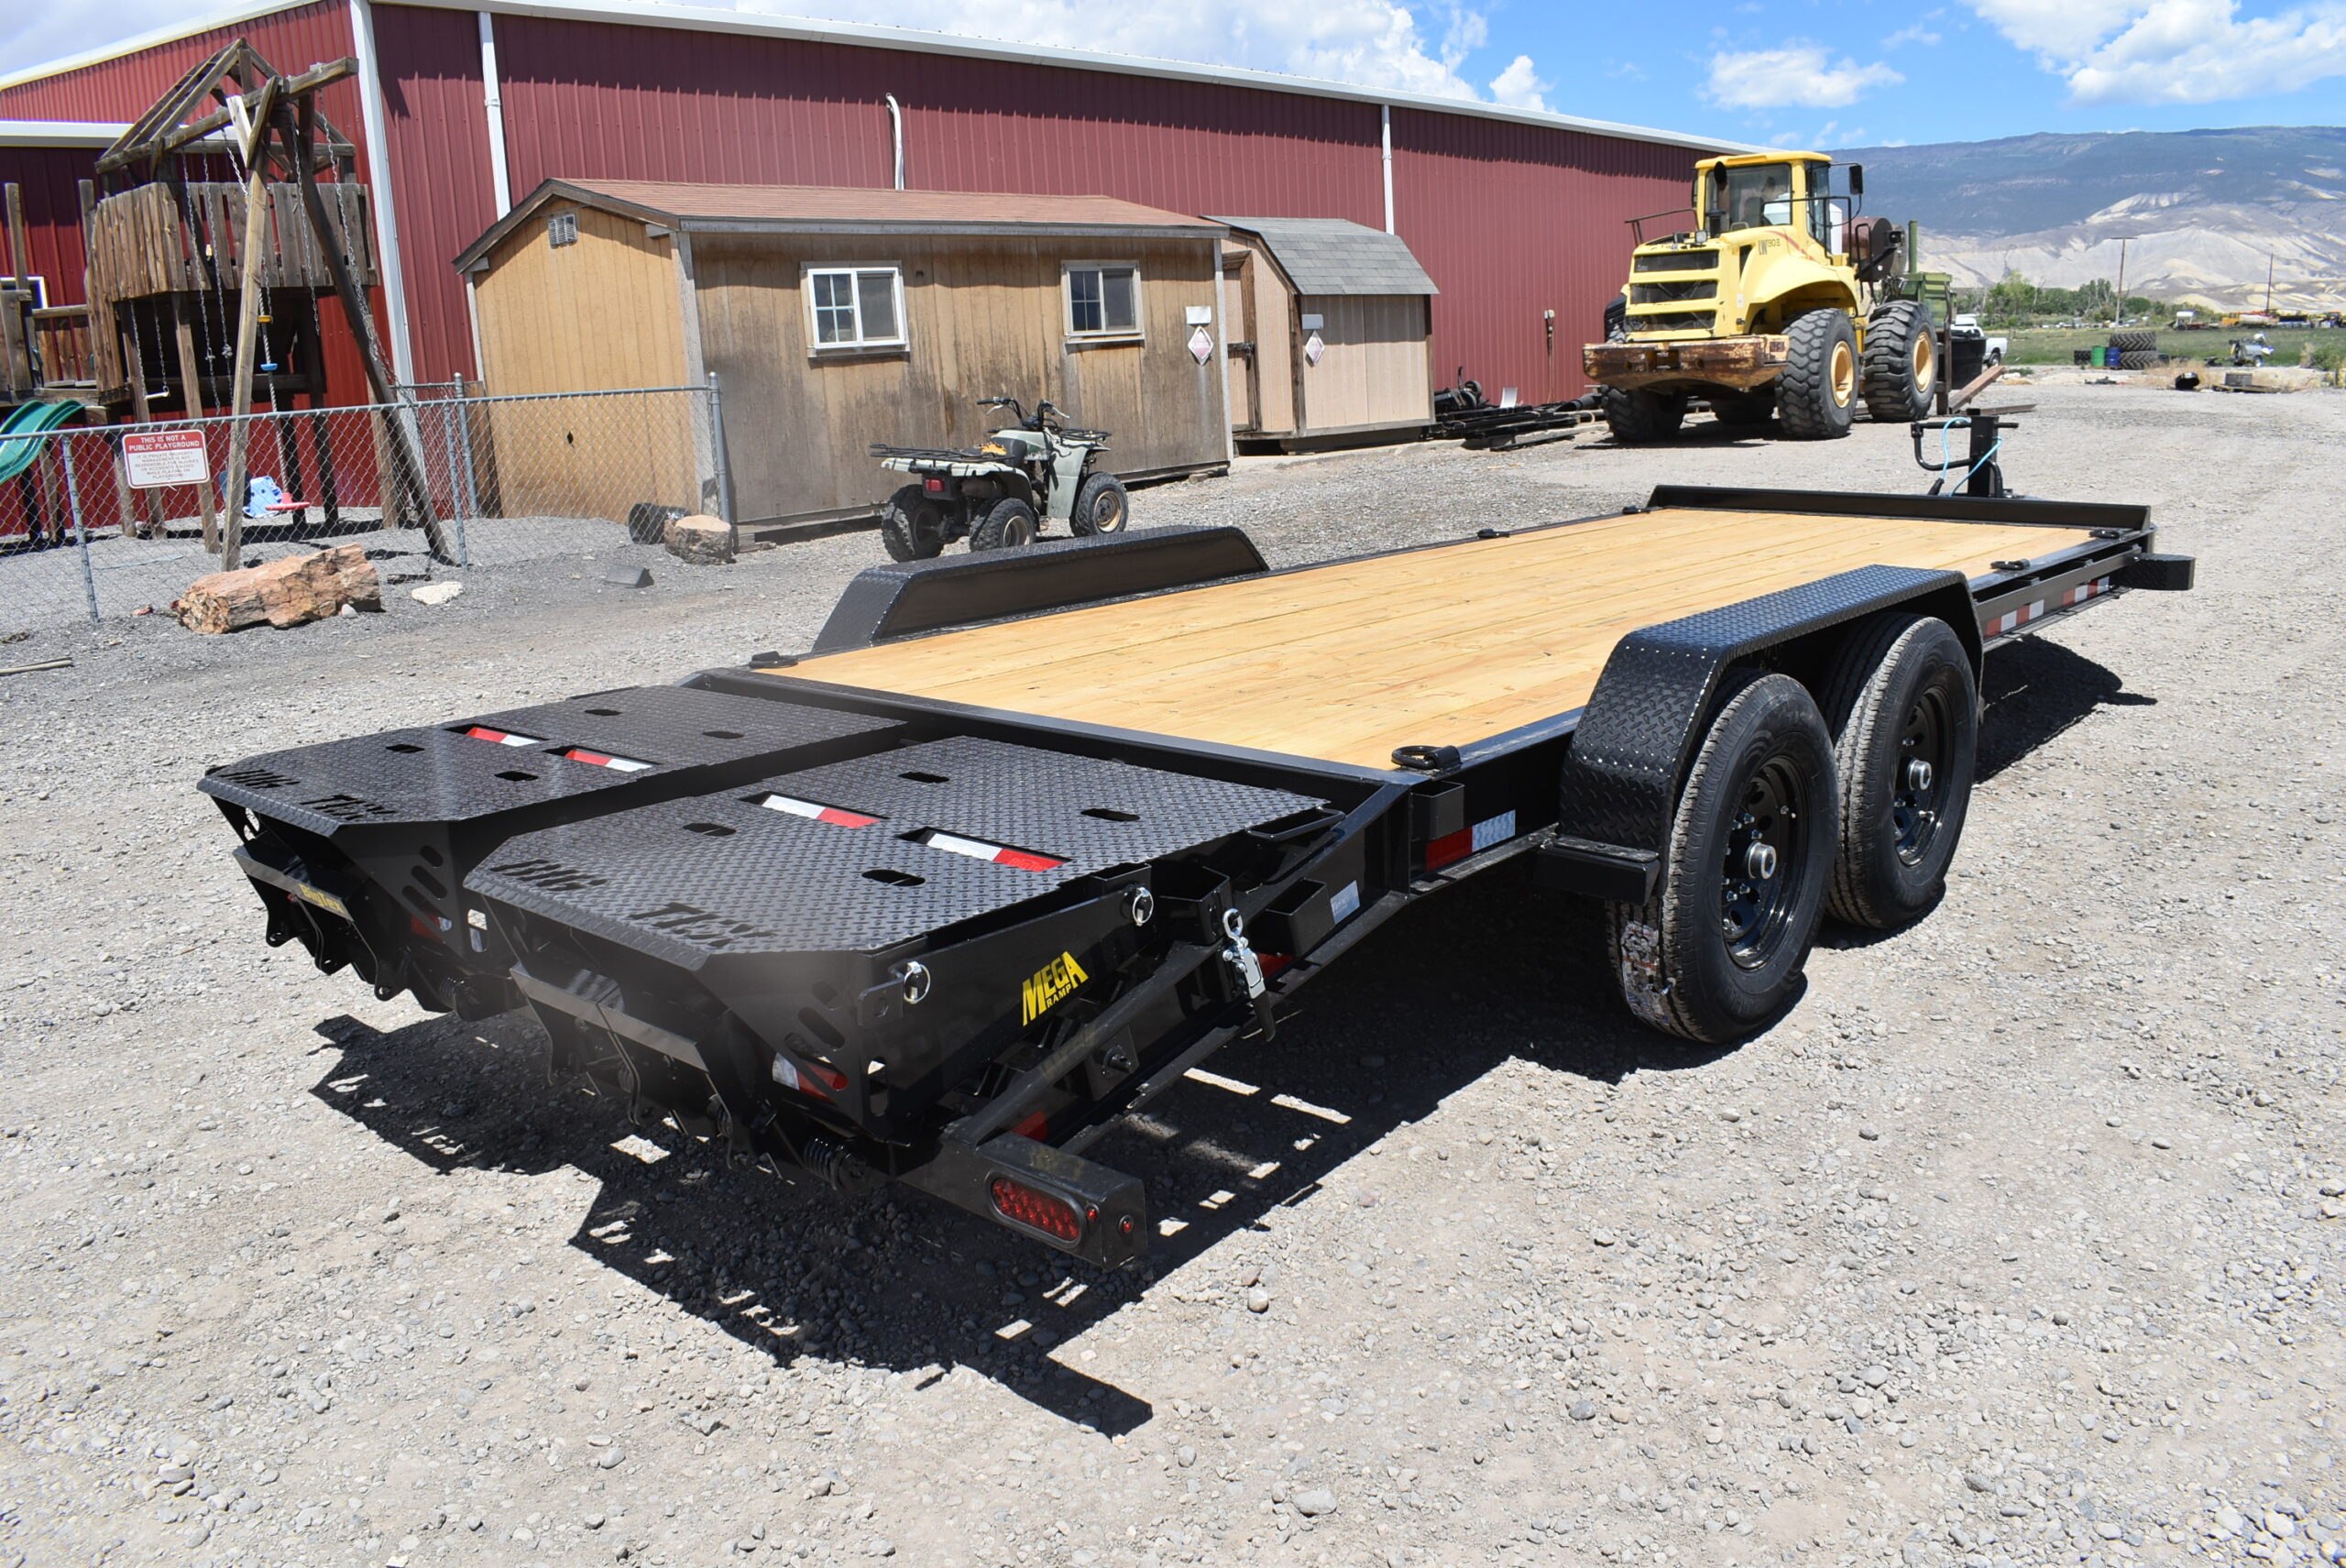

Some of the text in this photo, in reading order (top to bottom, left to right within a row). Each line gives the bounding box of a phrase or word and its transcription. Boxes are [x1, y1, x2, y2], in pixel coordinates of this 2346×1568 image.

[129, 440, 200, 452] PUBLIC PLAYGROUND
[1022, 950, 1090, 1026] MEGA
[1046, 983, 1072, 1008] RAMP
